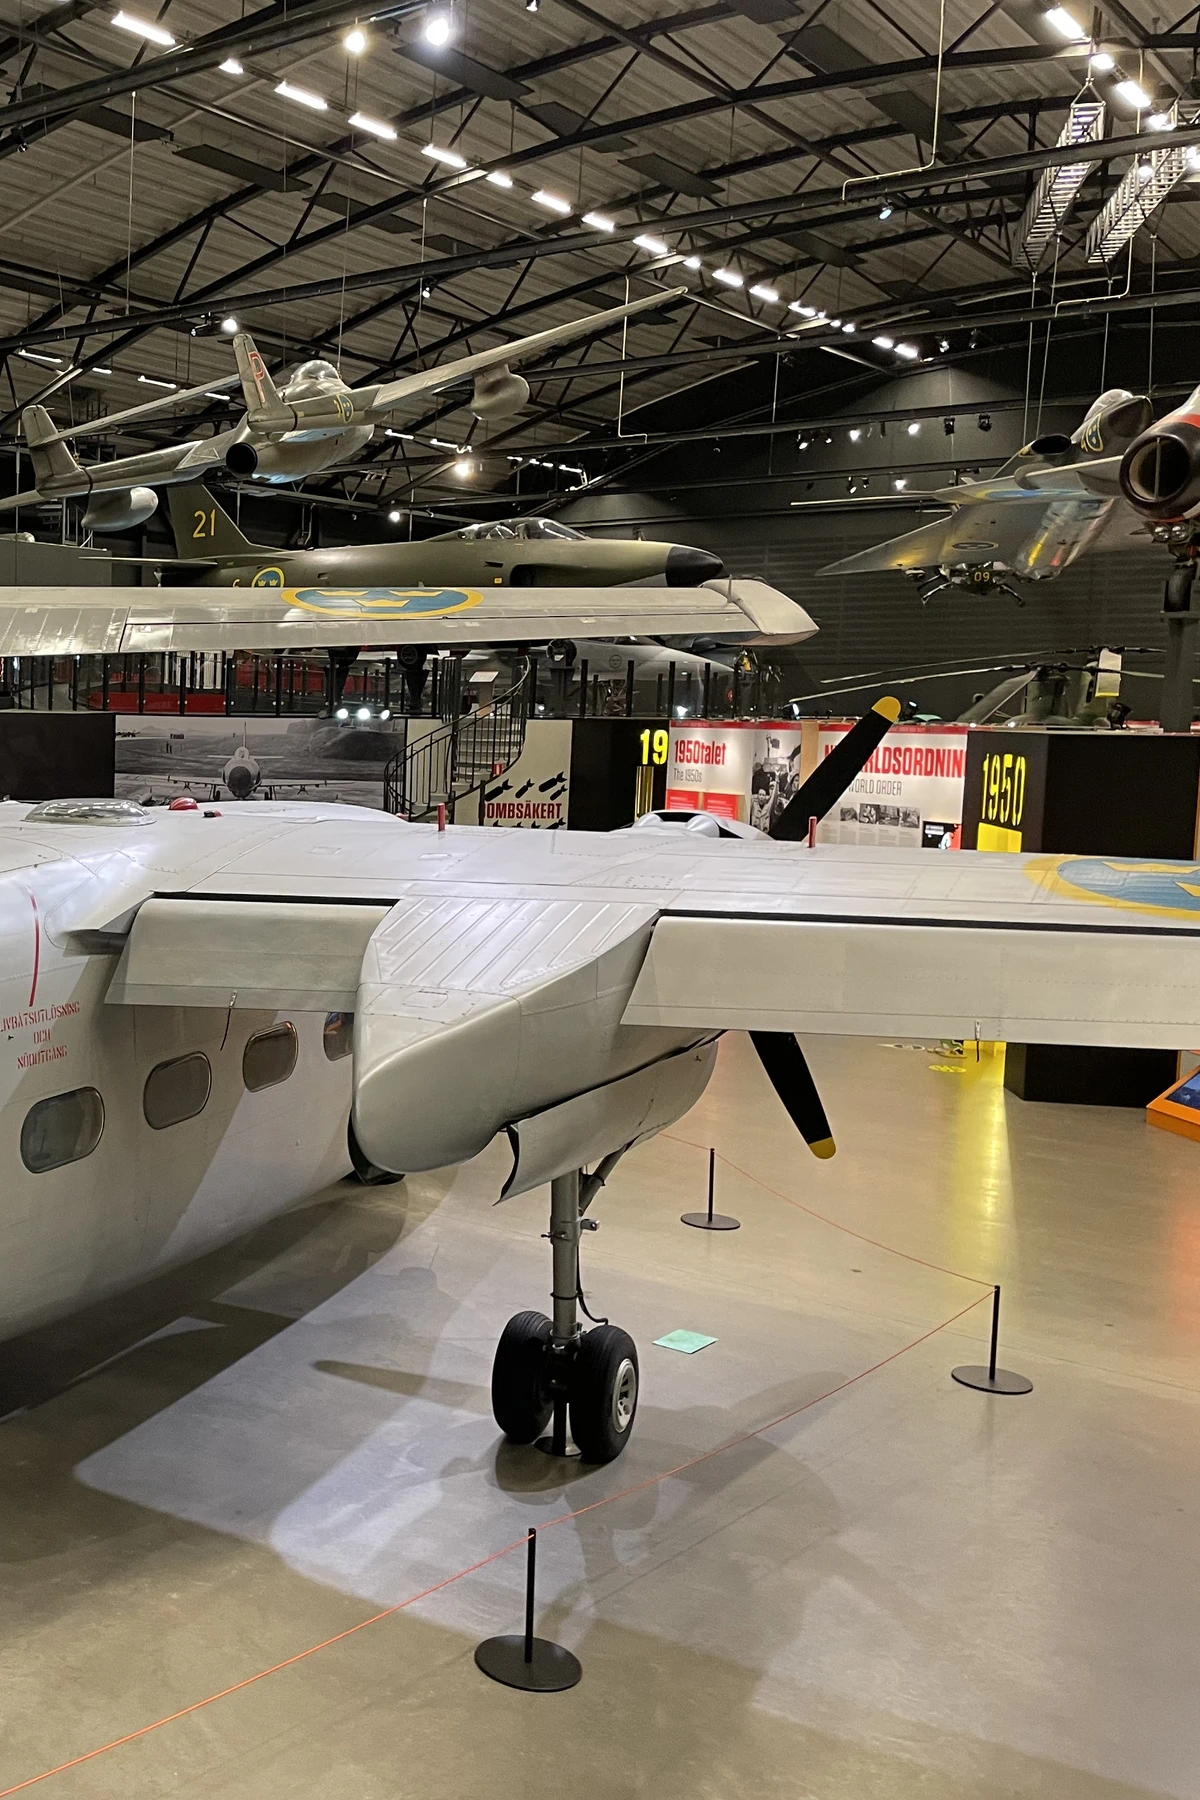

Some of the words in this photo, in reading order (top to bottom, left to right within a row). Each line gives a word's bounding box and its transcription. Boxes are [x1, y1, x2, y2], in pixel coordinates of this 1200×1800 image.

[192, 509, 216, 538] 21
[974, 571, 990, 582] 09
[640, 729, 668, 765] 19
[674, 740, 727, 765] 1950talet
[673, 768, 684, 781] The
[875, 780, 903, 796] ORDER
[982, 753, 1026, 827] 1950
[485, 800, 563, 819] OMBSÄKERT
[33, 1028, 51, 1044] OCH
[17, 1045, 68, 1070] NÖDUTGÅNG
